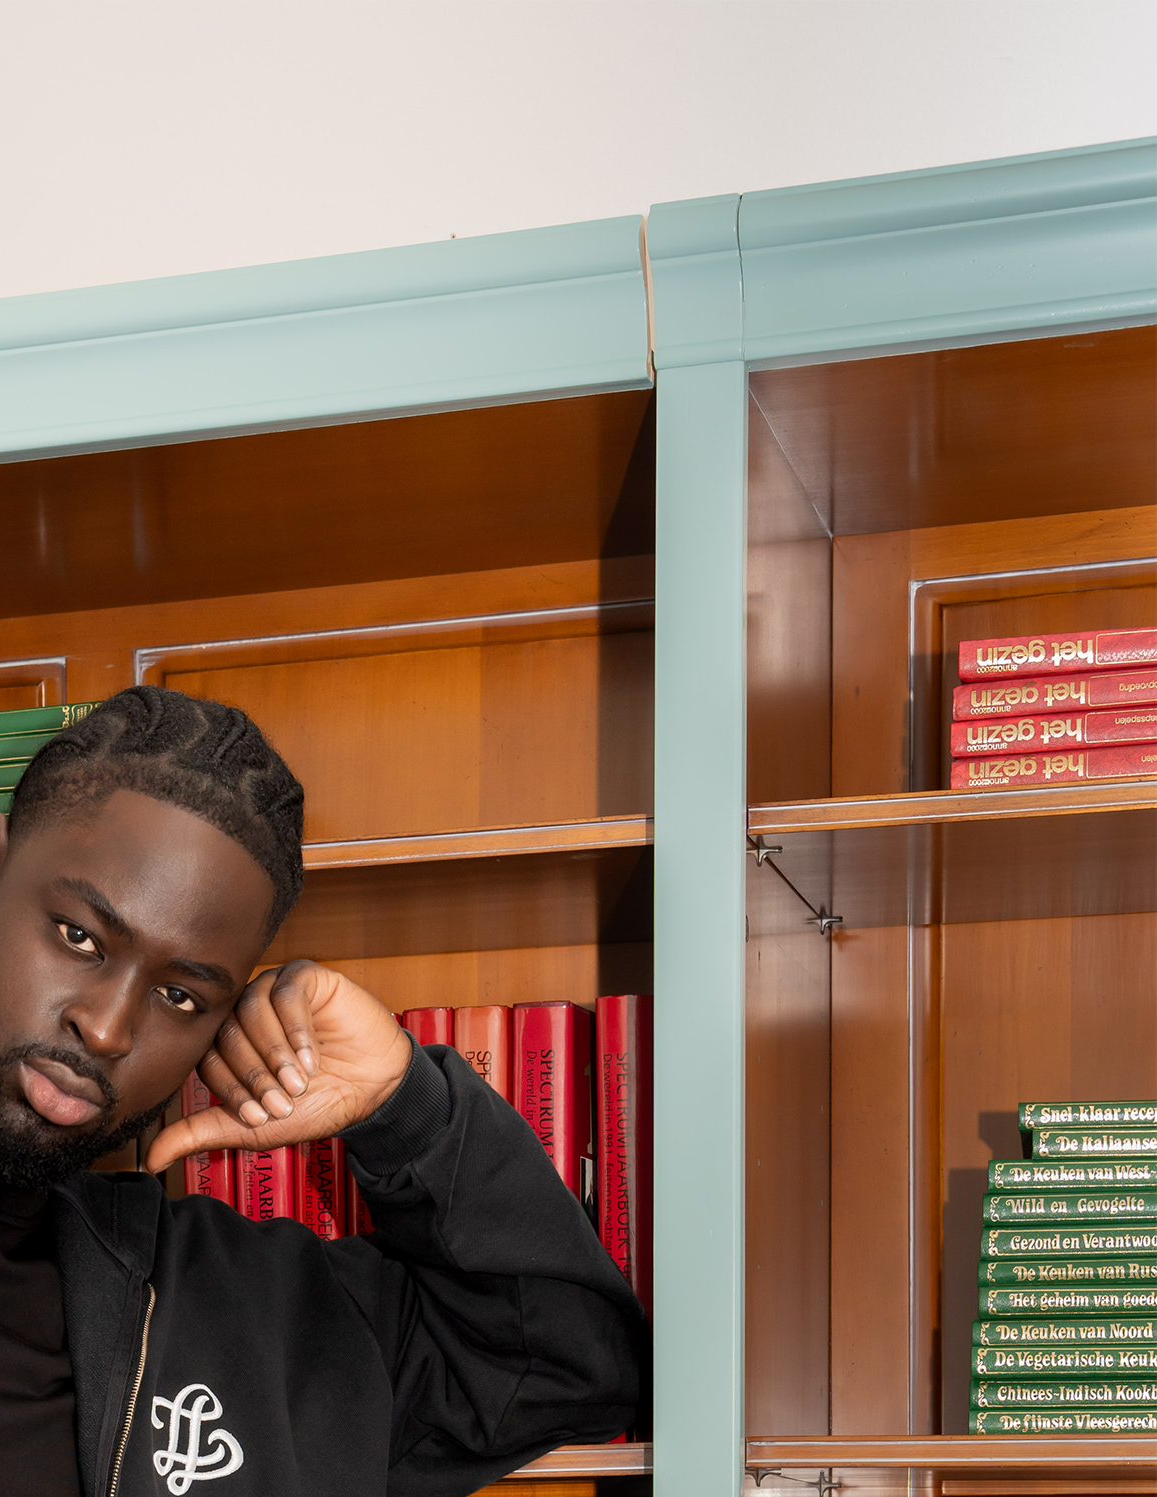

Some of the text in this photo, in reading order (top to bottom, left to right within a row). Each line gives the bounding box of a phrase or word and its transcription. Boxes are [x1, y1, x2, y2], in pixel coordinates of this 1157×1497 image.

[977, 639, 1093, 667] het gezin
[970, 681, 1085, 707] het gezin
[967, 718, 1082, 744] het gezin
[969, 754, 1084, 779] het gezin
[526, 1051, 537, 1065] De
[526, 1069, 537, 1105] wereld
[539, 1049, 555, 1147] SPECTRUM
[617, 1052, 632, 1249] SPECTRUM JAARBOEK
[1056, 1135, 1157, 1151] De Italiaanse
[1006, 1196, 1145, 1214] Wild en Gevogelte
[1010, 1234, 1060, 1250] Gezond
[1063, 1236, 1080, 1249] en
[996, 1325, 1018, 1340] De
[1021, 1324, 1076, 1340] Keuken
[1079, 1326, 1106, 1339] van
[995, 1352, 1014, 1367] De
[1016, 1351, 1113, 1370] Vegetarische
[1000, 1416, 1021, 1430] De
[1022, 1415, 1073, 1432] fijnste
